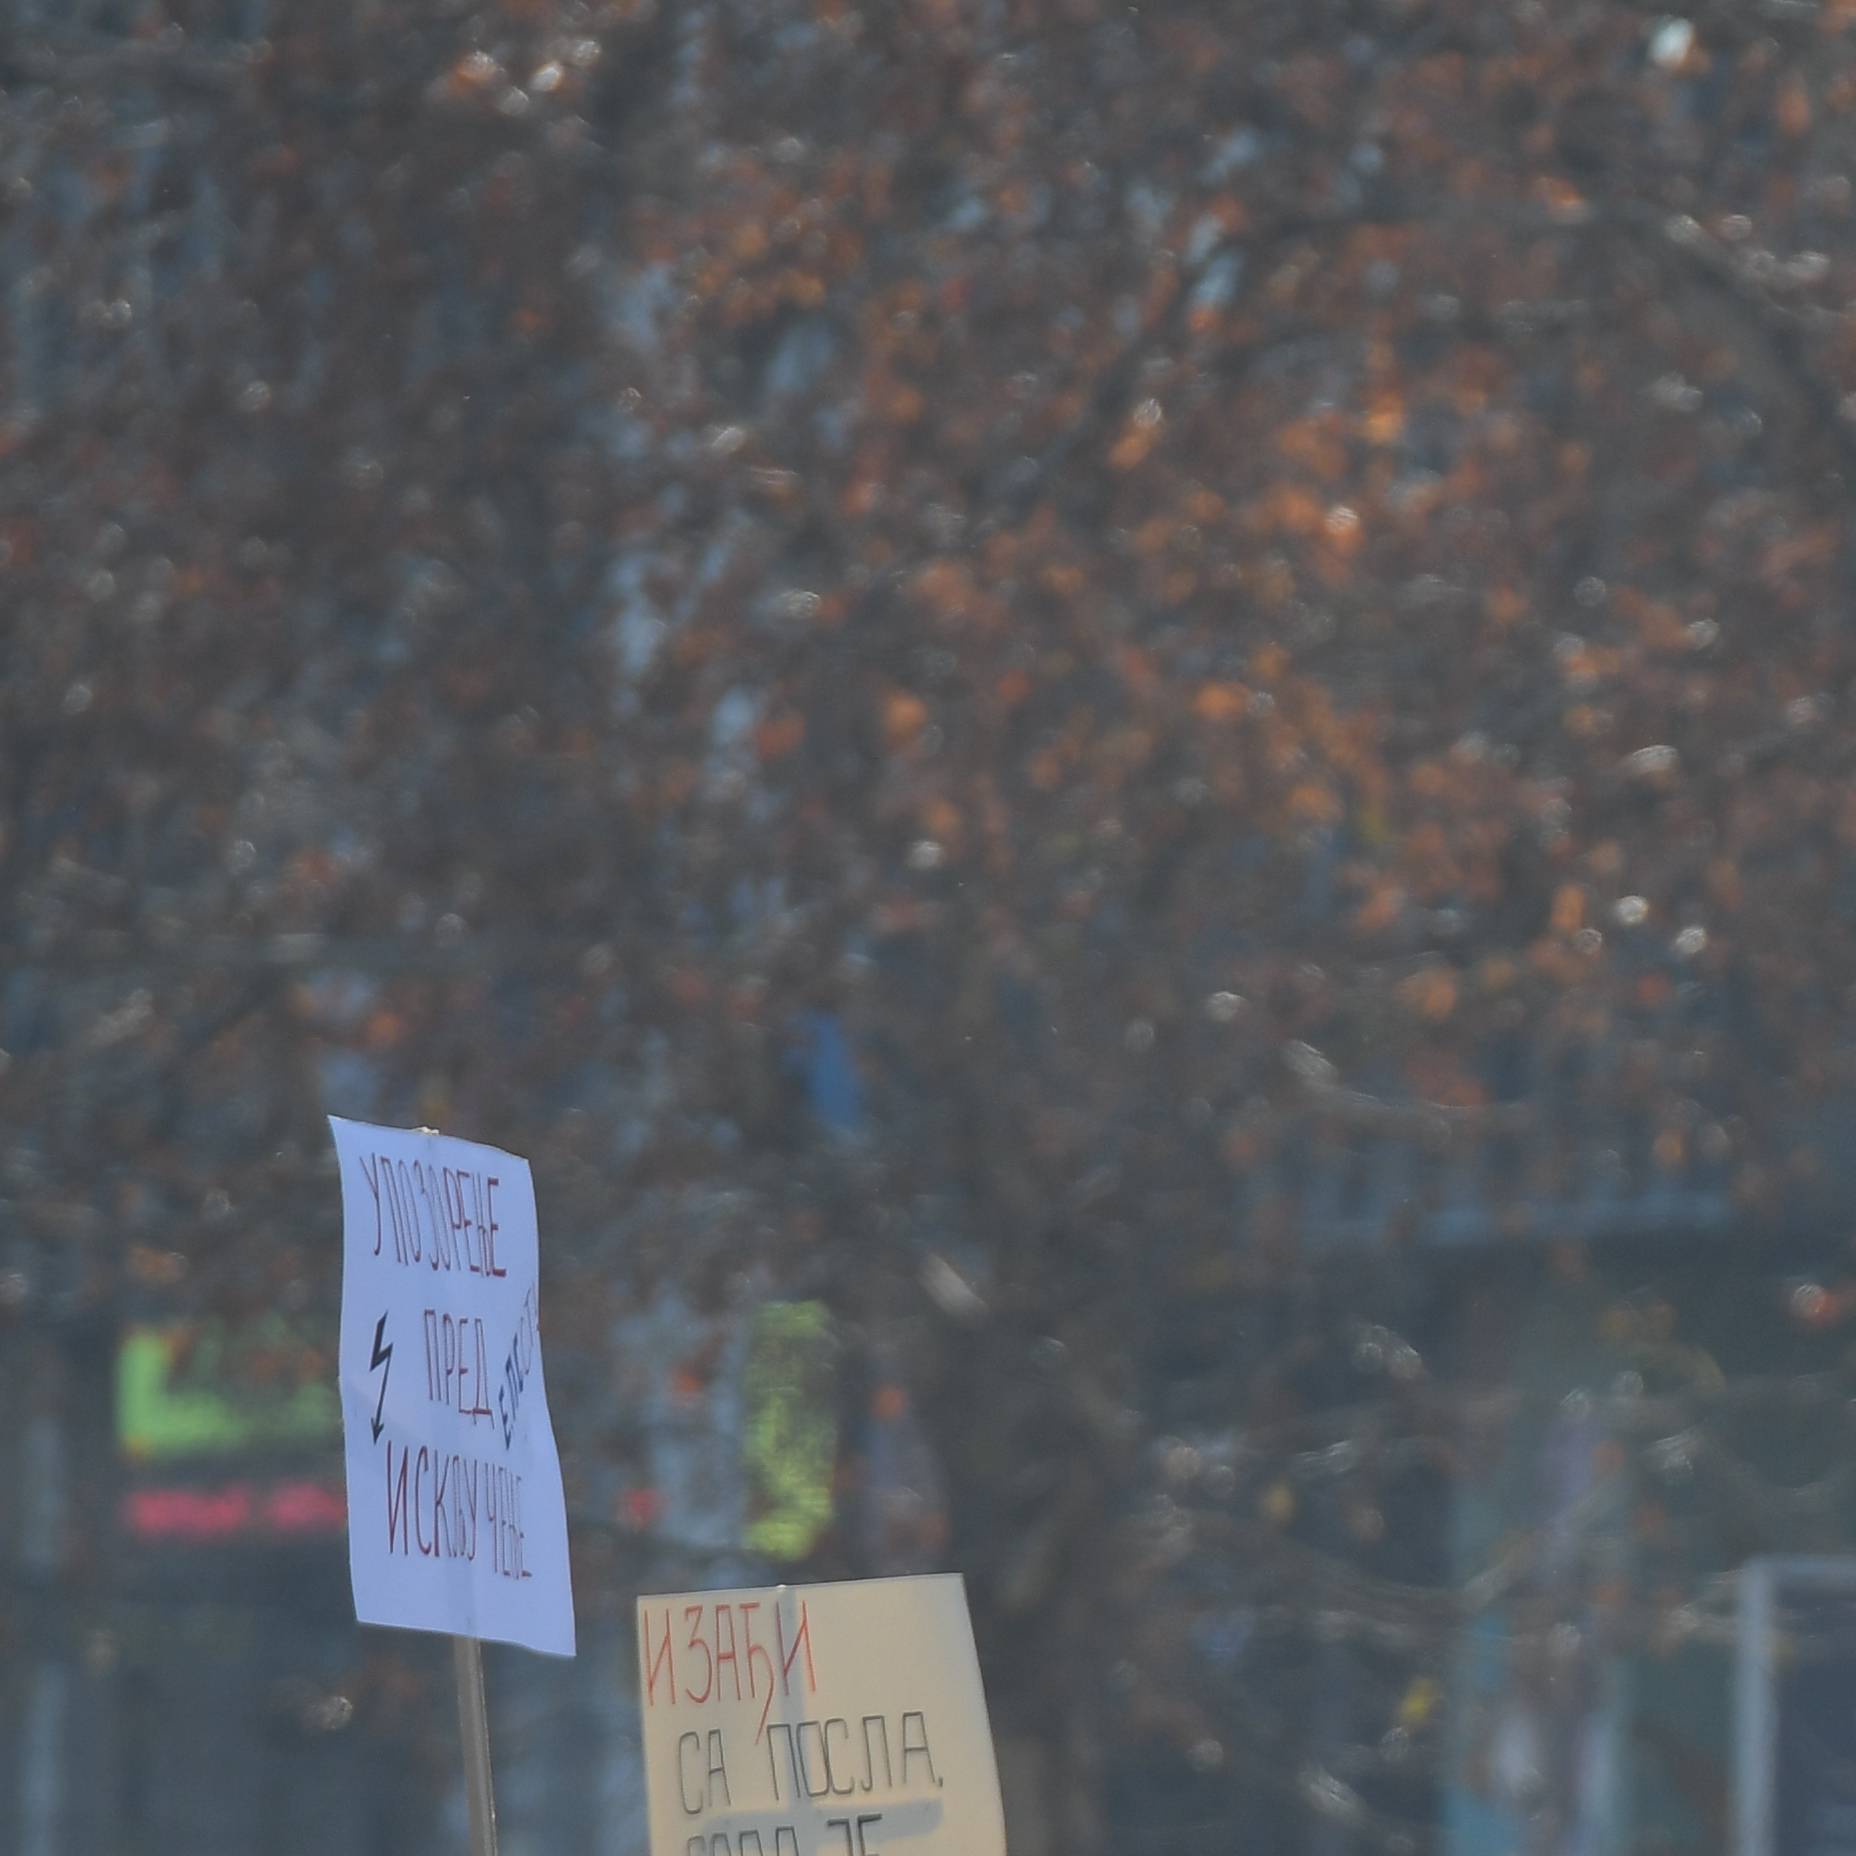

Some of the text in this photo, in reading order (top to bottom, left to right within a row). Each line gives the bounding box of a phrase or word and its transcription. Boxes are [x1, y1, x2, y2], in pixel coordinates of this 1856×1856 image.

[424, 1309, 495, 1430] ПРЕД
[644, 1600, 817, 1746] ИЗАЂИ
[678, 1728, 732, 1815] СА
